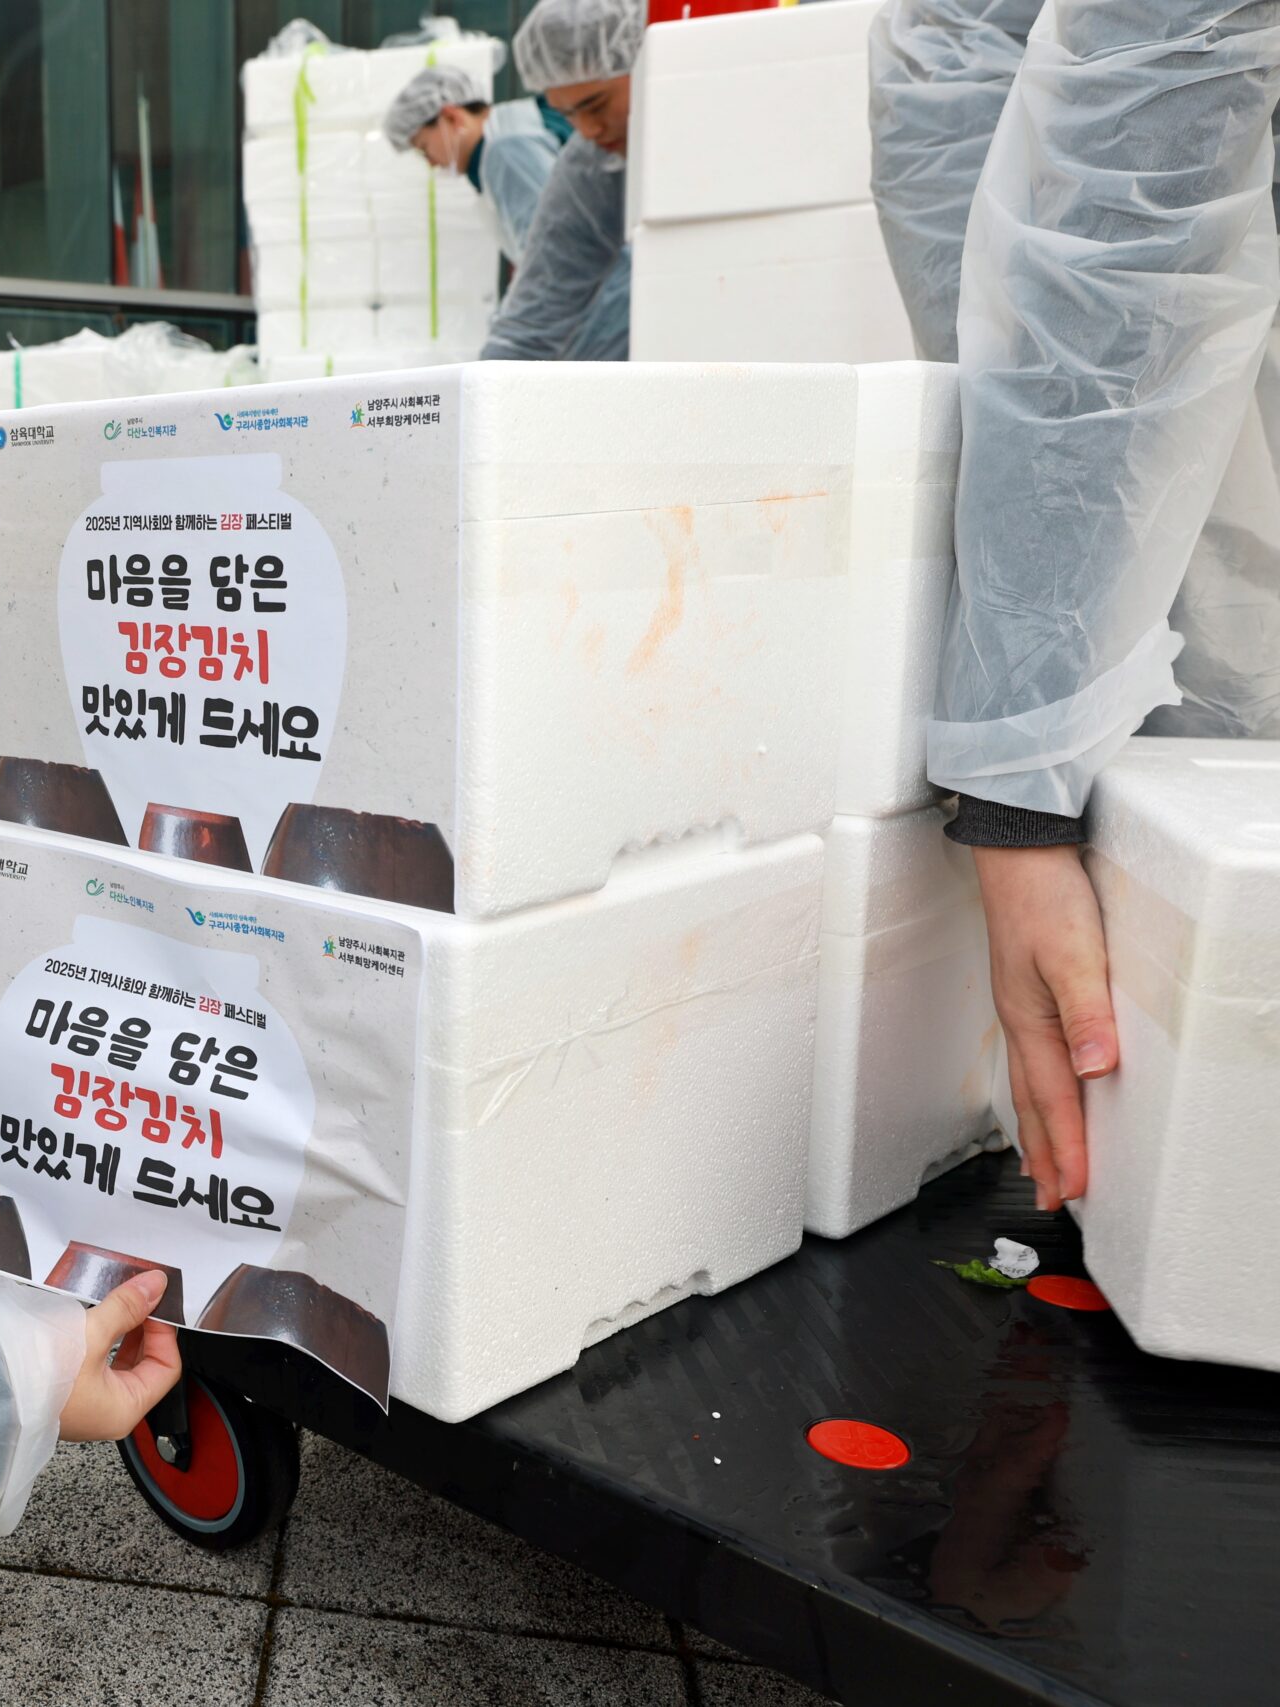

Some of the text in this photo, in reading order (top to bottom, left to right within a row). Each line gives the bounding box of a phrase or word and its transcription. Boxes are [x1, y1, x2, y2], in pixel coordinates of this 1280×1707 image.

[368, 394, 440, 411] 남양주시 사회복지관
[127, 424, 176, 438] 다산노인복지관
[236, 416, 308, 431] 구리시종합사회복지관
[367, 412, 440, 428] 서부희망케어센터
[10, 426, 54, 441] 삼육대학교
[86, 513, 292, 531] 2025년 지역사회와 함께하는 김장 페스티벌
[86, 554, 287, 612] 마음을 담은
[118, 622, 269, 684] 김장김치
[82, 684, 321, 761] 맛있게 드세요
[109, 890, 154, 912] 다산노인복지관
[209, 920, 285, 942] 구리시종합사회복지관
[338, 936, 405, 962] 남양주시 사회복지관
[338, 951, 404, 977] 서부희망케어센터
[45, 958, 267, 1029] 2025년 지역사회와 함께하는 김장 페스티벌
[25, 999, 258, 1100] 마음을 담은
[50, 1062, 223, 1159] 김장김치
[0, 1114, 282, 1232] 맛있게 드세요
